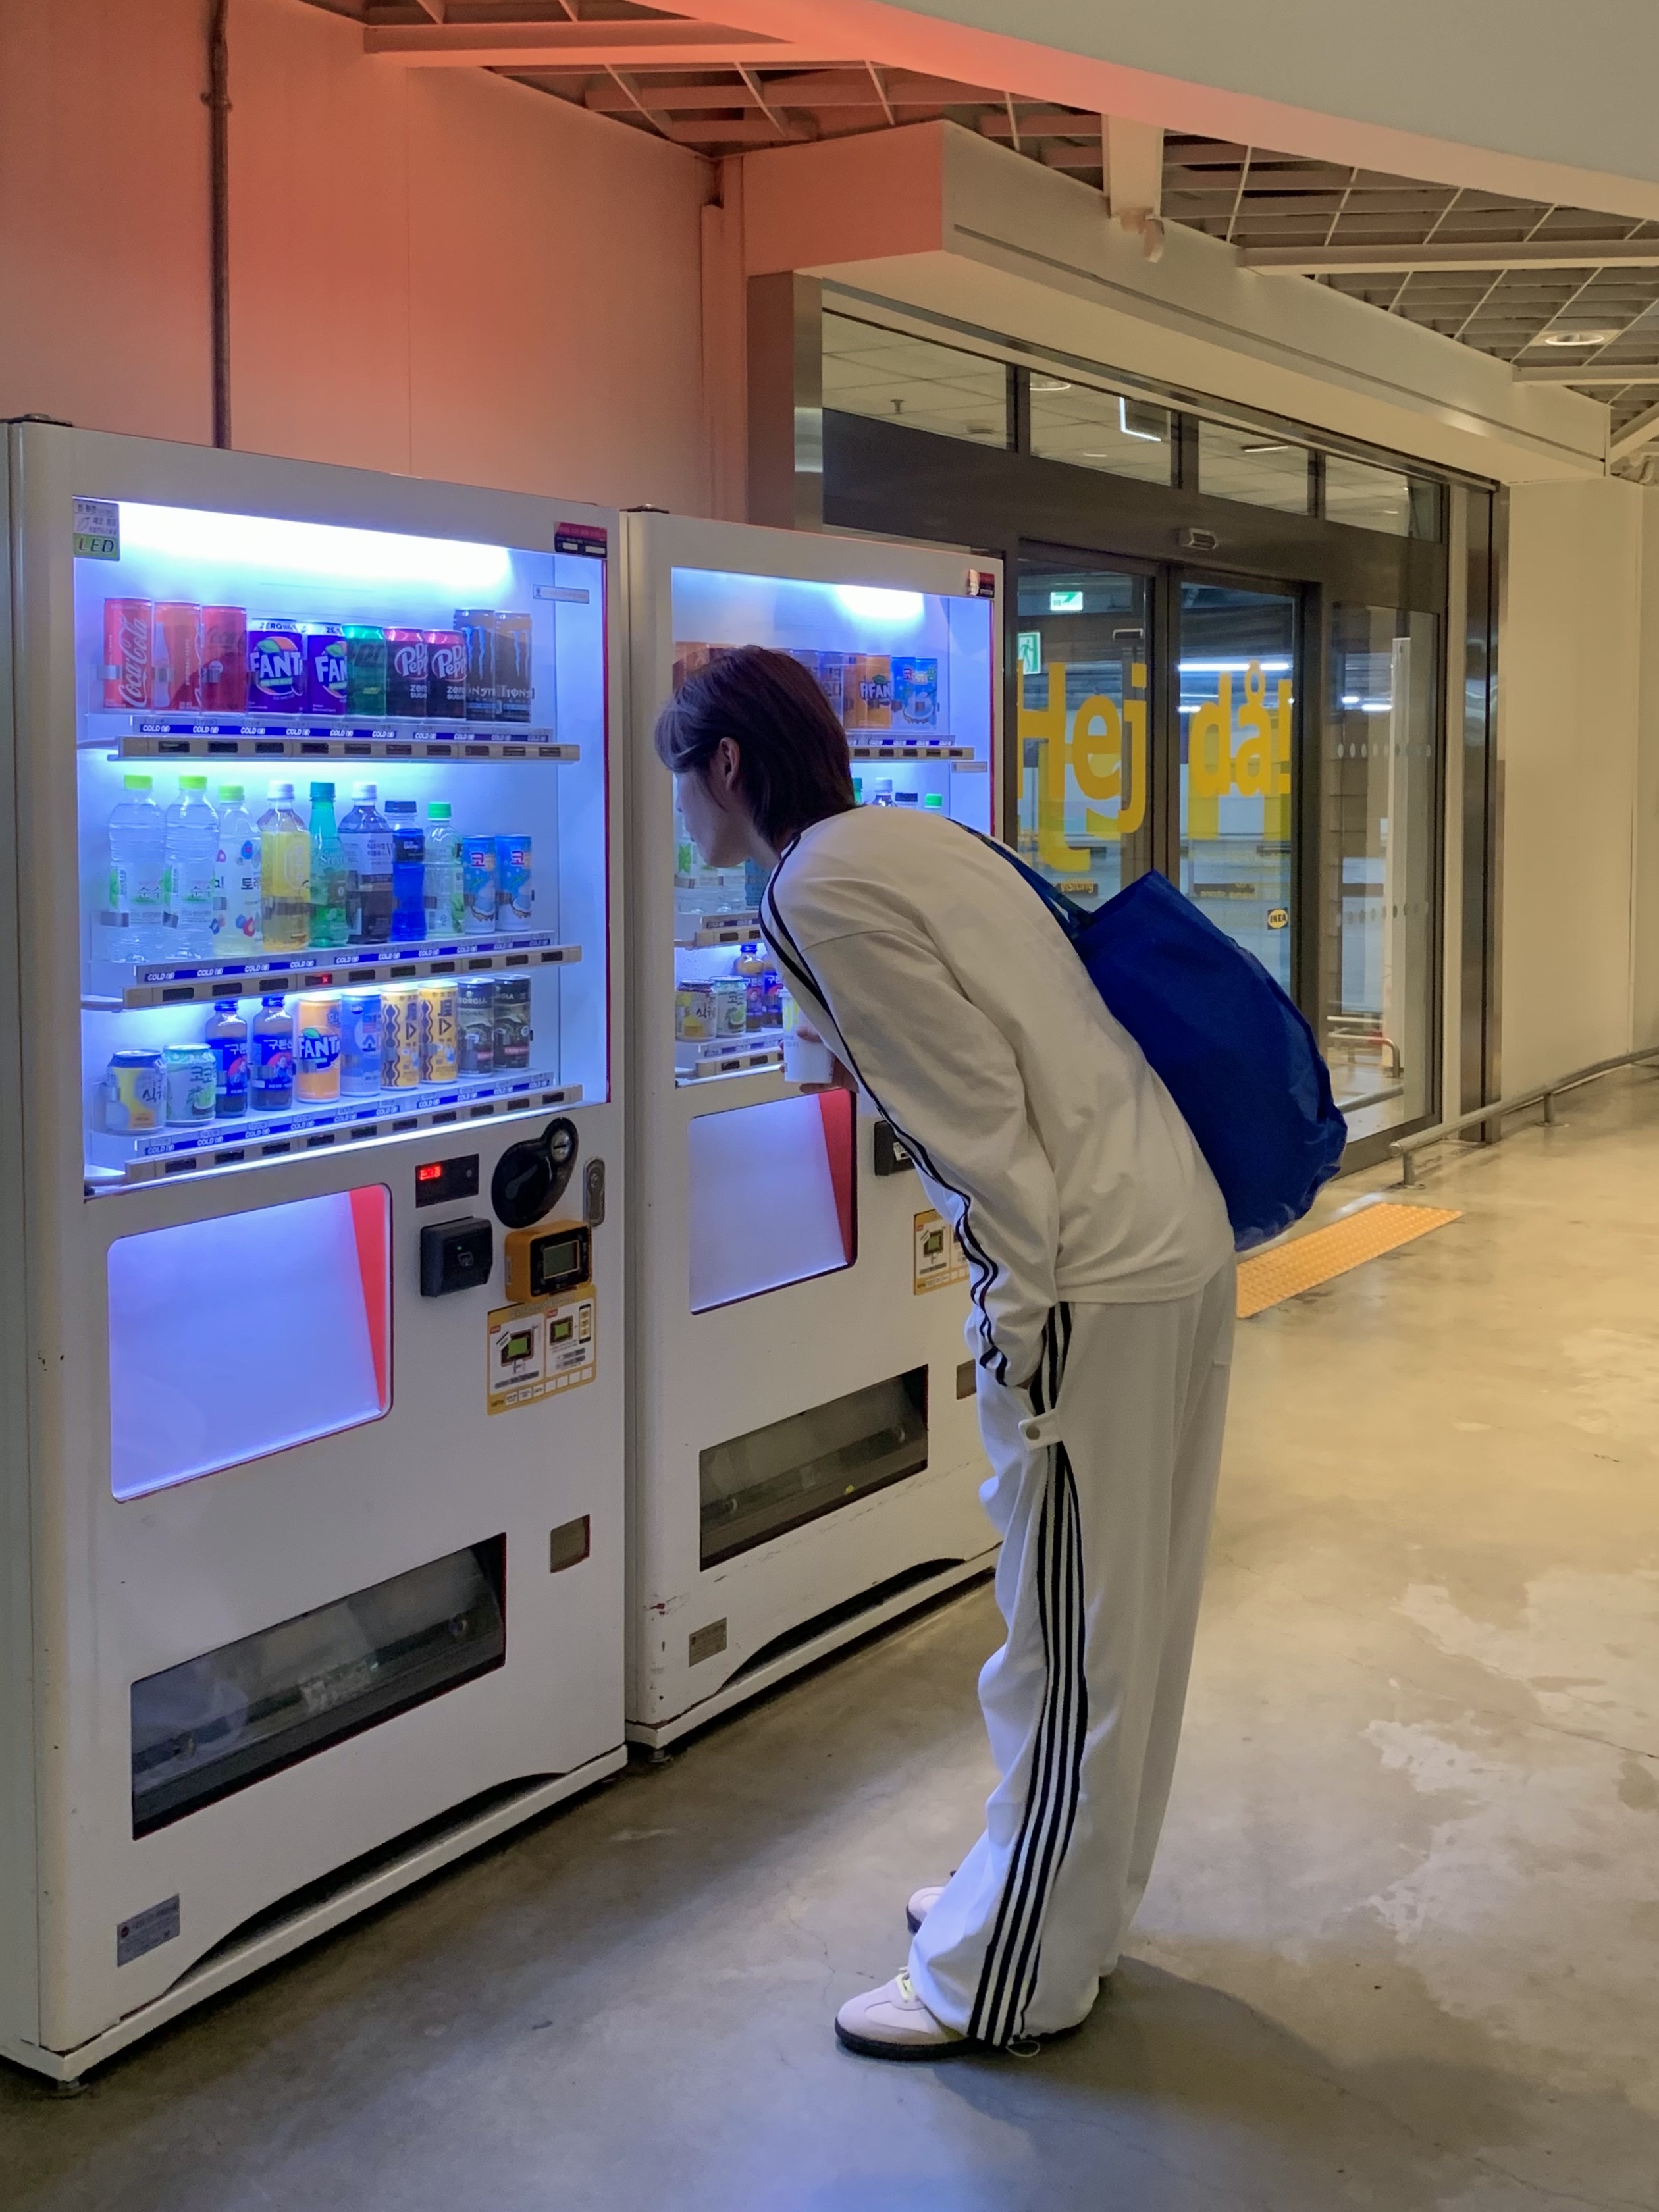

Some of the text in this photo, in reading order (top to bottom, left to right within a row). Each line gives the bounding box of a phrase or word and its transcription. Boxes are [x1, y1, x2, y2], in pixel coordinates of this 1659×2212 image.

[78, 537, 115, 553] LED
[1017, 658, 1292, 834] Hej då!
[1270, 914, 1286, 923] IKEA
[198, 1138, 213, 1146] COLD
[148, 1146, 165, 1155] COLD
